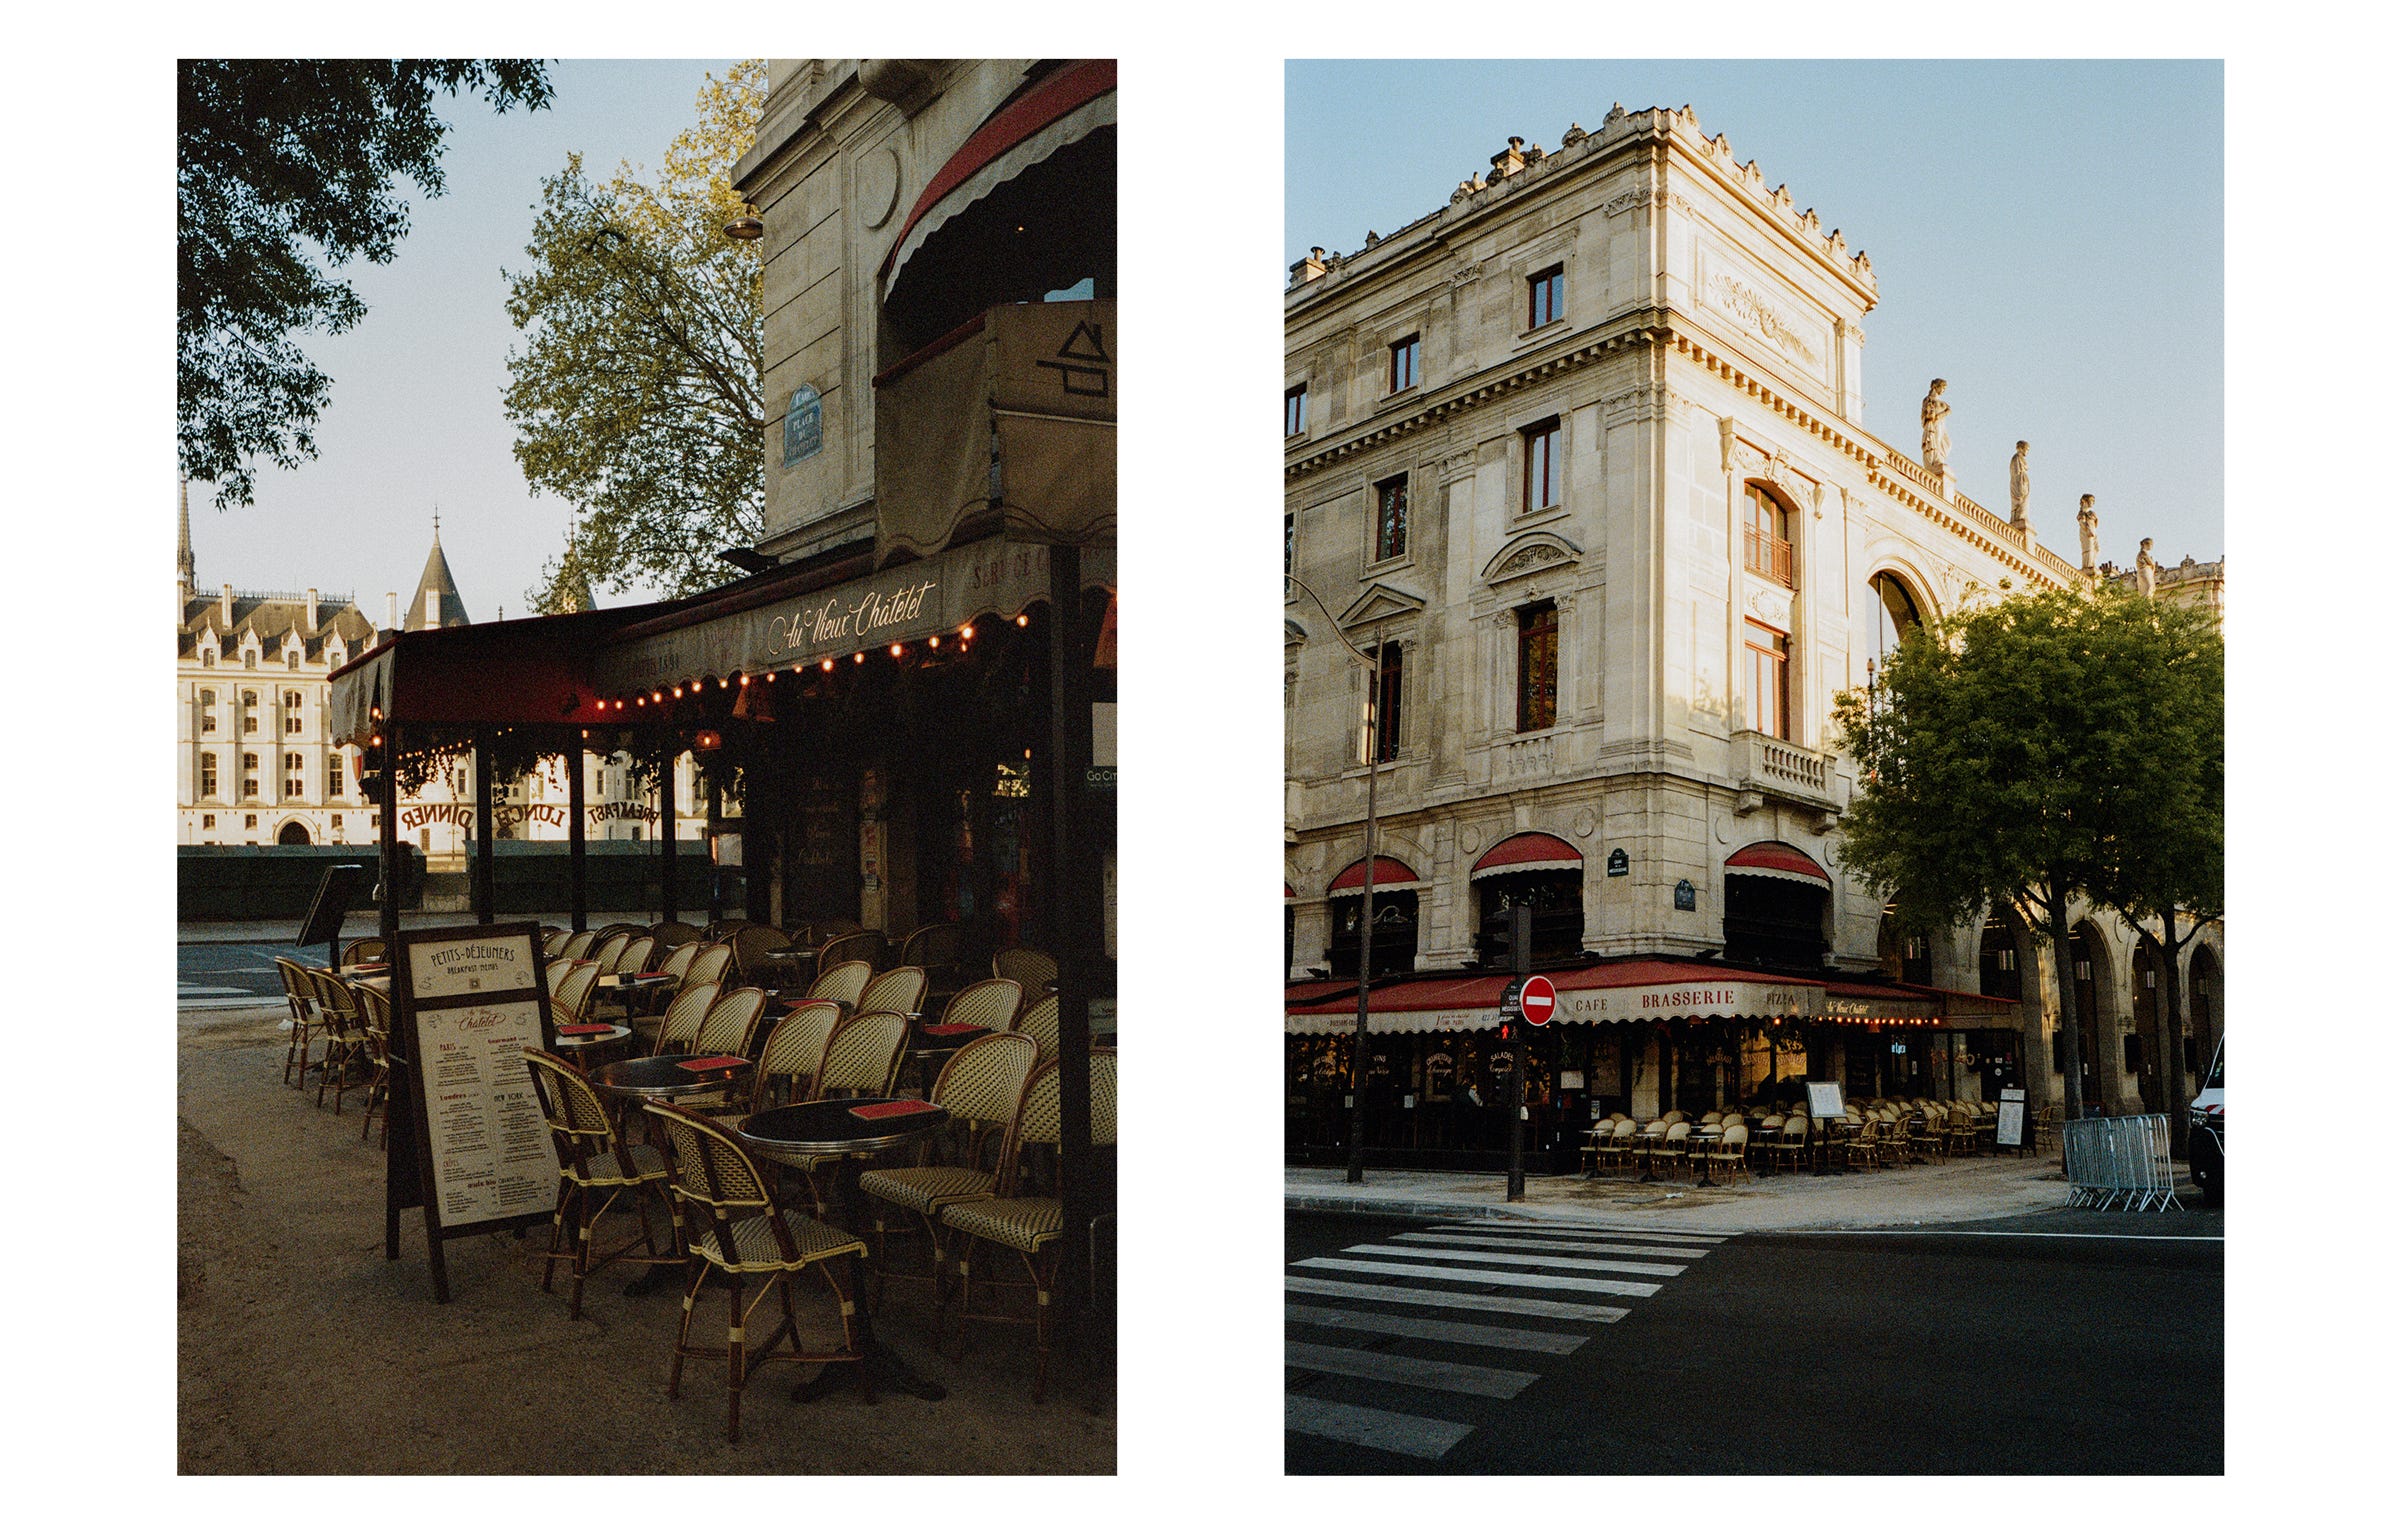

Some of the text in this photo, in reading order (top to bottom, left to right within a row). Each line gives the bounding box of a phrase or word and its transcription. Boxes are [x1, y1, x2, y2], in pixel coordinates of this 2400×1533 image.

[768, 613, 803, 655] Au
[804, 598, 850, 644] Vieux
[849, 580, 936, 636] Châtelet
[431, 943, 515, 967] PETITS-DÉJEUNERS
[447, 964, 477, 975] BREAKFAST
[1642, 990, 1734, 1008] BRASSERIE
[1766, 992, 1796, 1006] PIZZA
[508, 1092, 523, 1100] YORK
